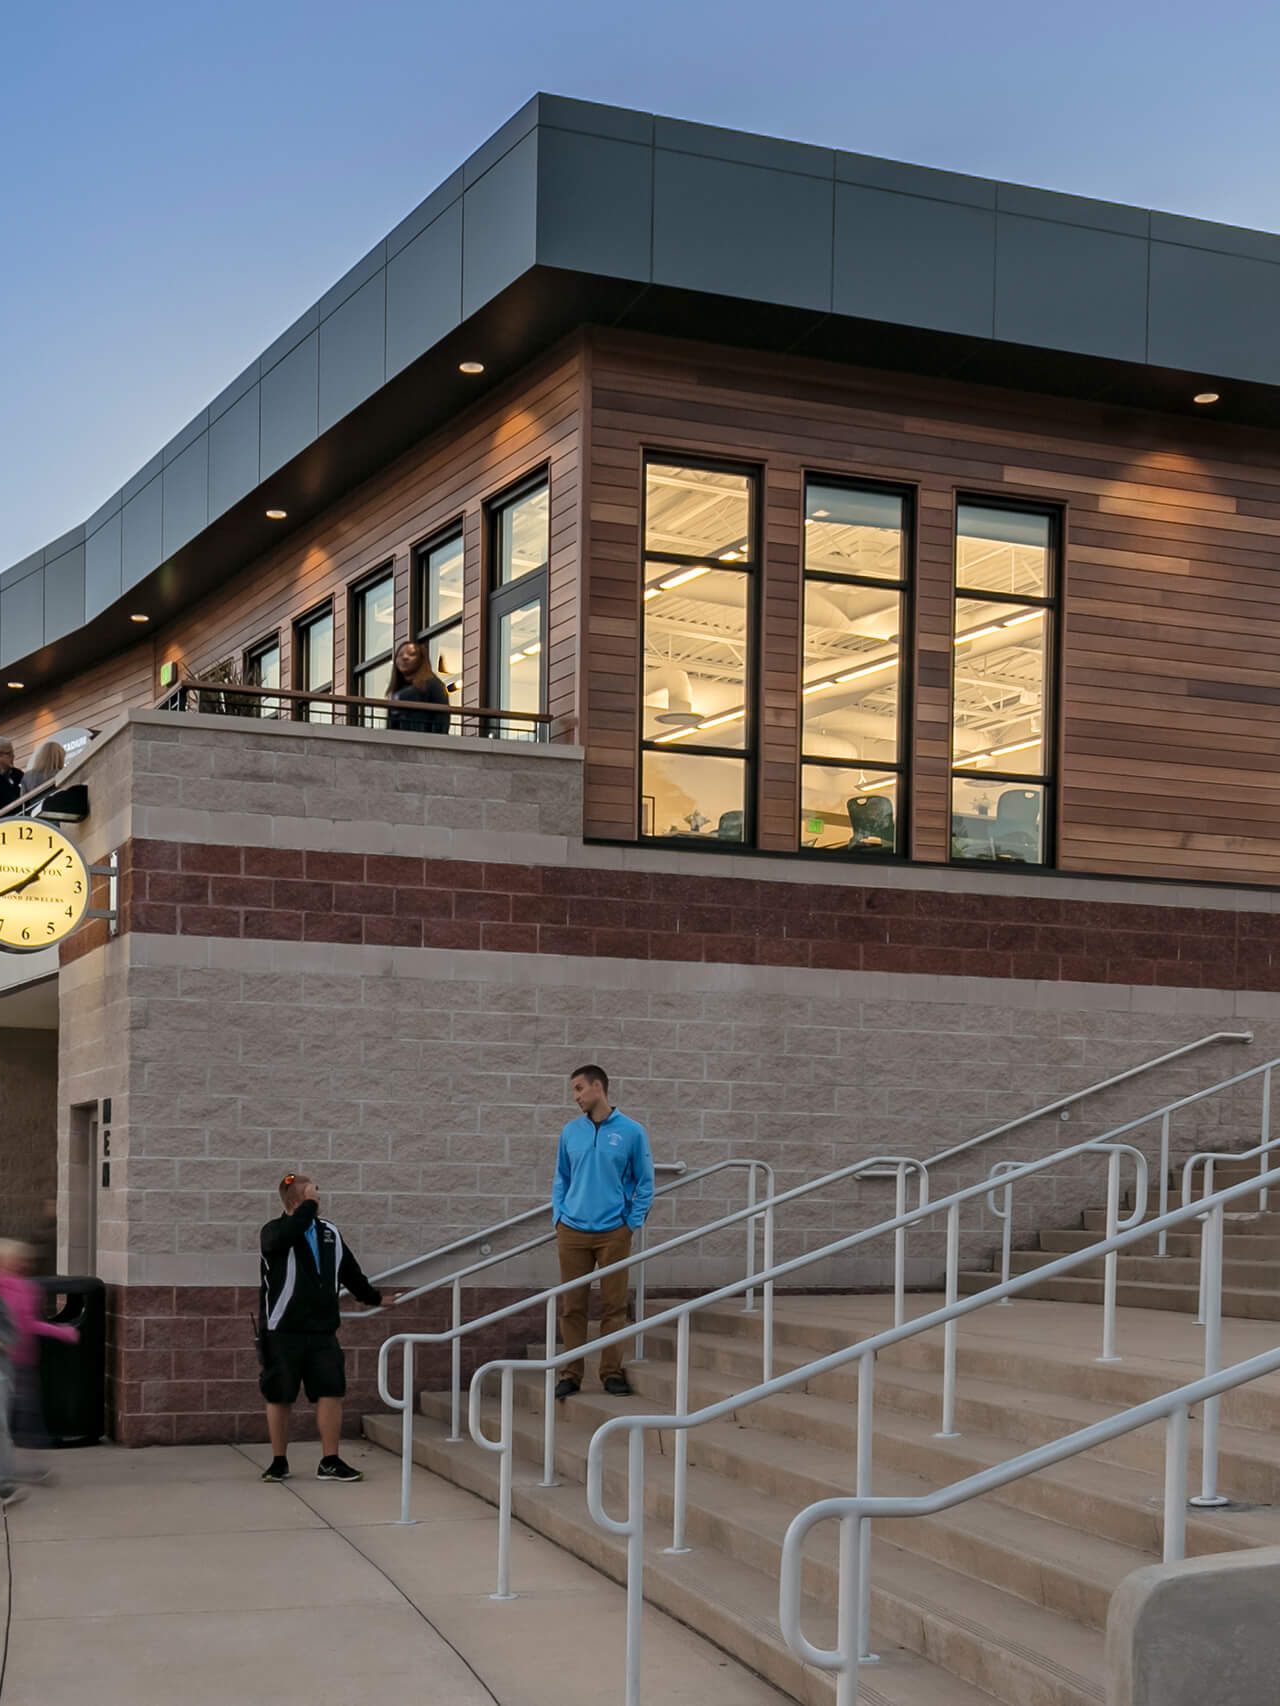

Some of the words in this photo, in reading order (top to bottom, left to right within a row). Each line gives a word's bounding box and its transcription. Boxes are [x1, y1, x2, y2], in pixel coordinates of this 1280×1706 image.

[18, 826, 33, 841] 12
[47, 836, 54, 849] 1
[64, 855, 73, 869] 2
[73, 880, 82, 894] 3
[64, 904, 73, 918] 4
[21, 927, 30, 940] 6
[46, 921, 56, 935] 5
